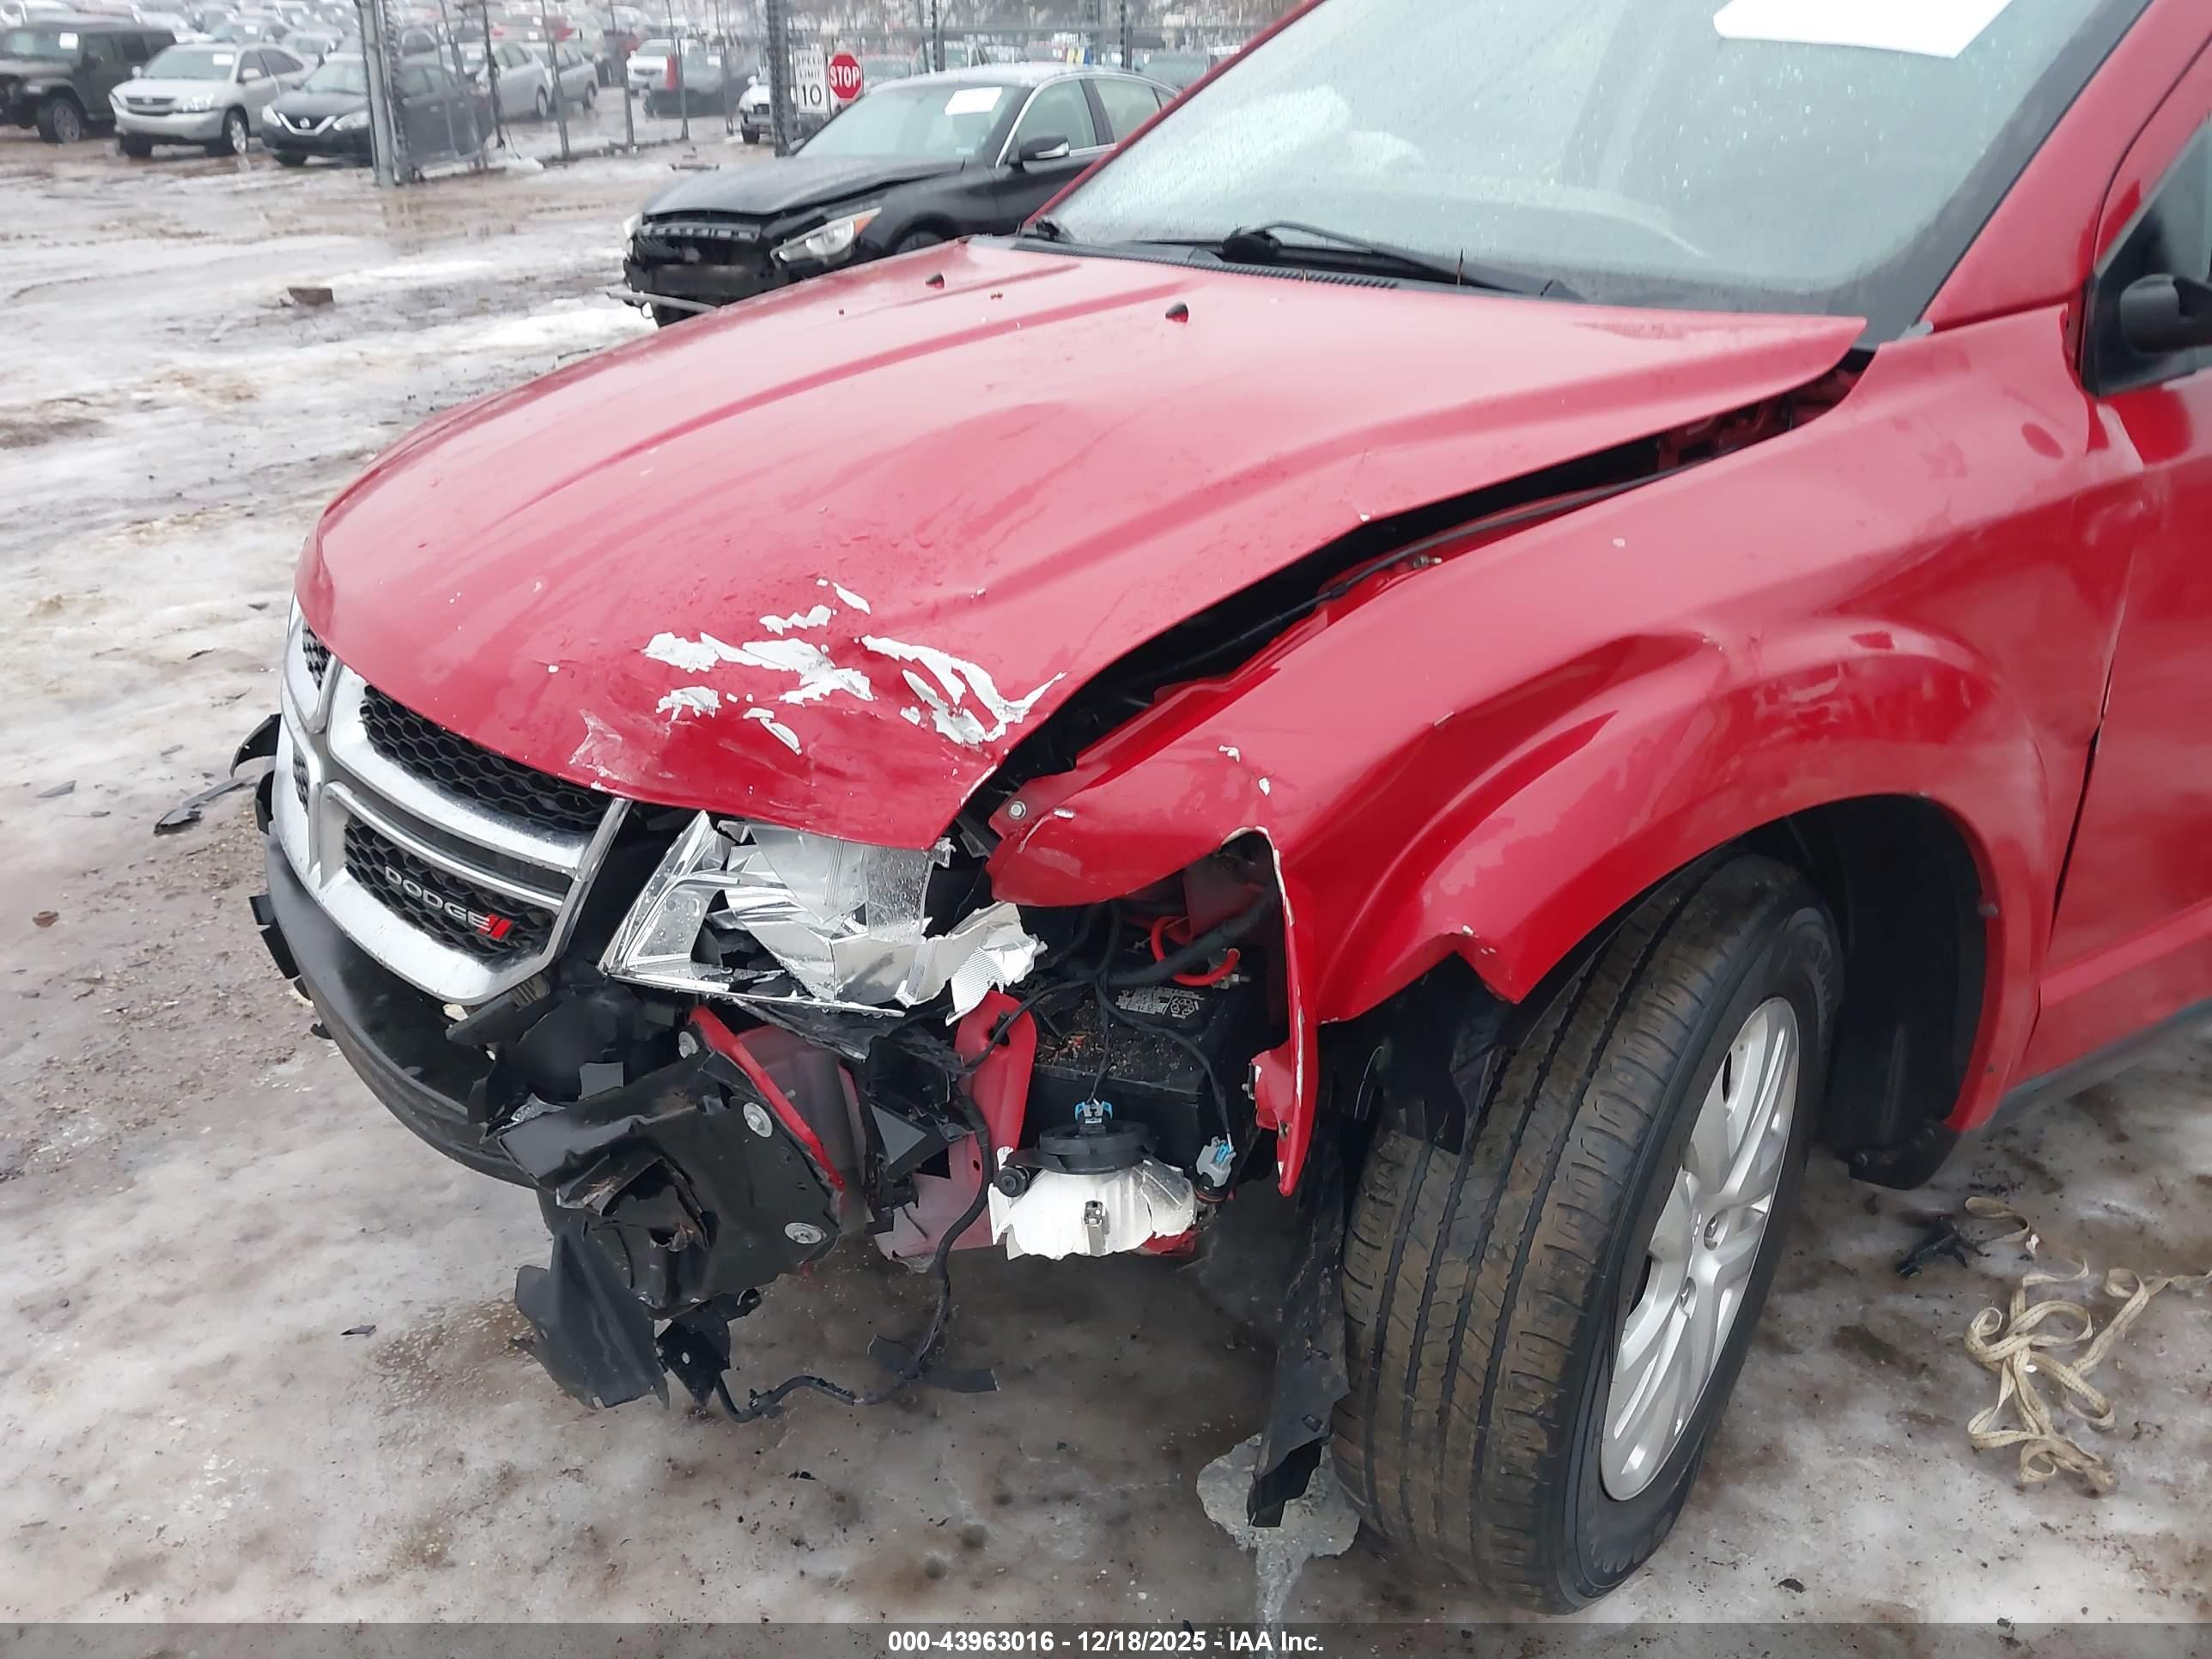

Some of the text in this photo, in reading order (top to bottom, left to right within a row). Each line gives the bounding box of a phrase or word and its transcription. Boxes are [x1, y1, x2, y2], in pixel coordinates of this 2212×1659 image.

[797, 55, 822, 65] SPEED
[799, 69, 820, 79] LIMIT
[830, 65, 860, 88] STOP
[802, 84, 822, 106] 10
[385, 866, 491, 932] DODGE
